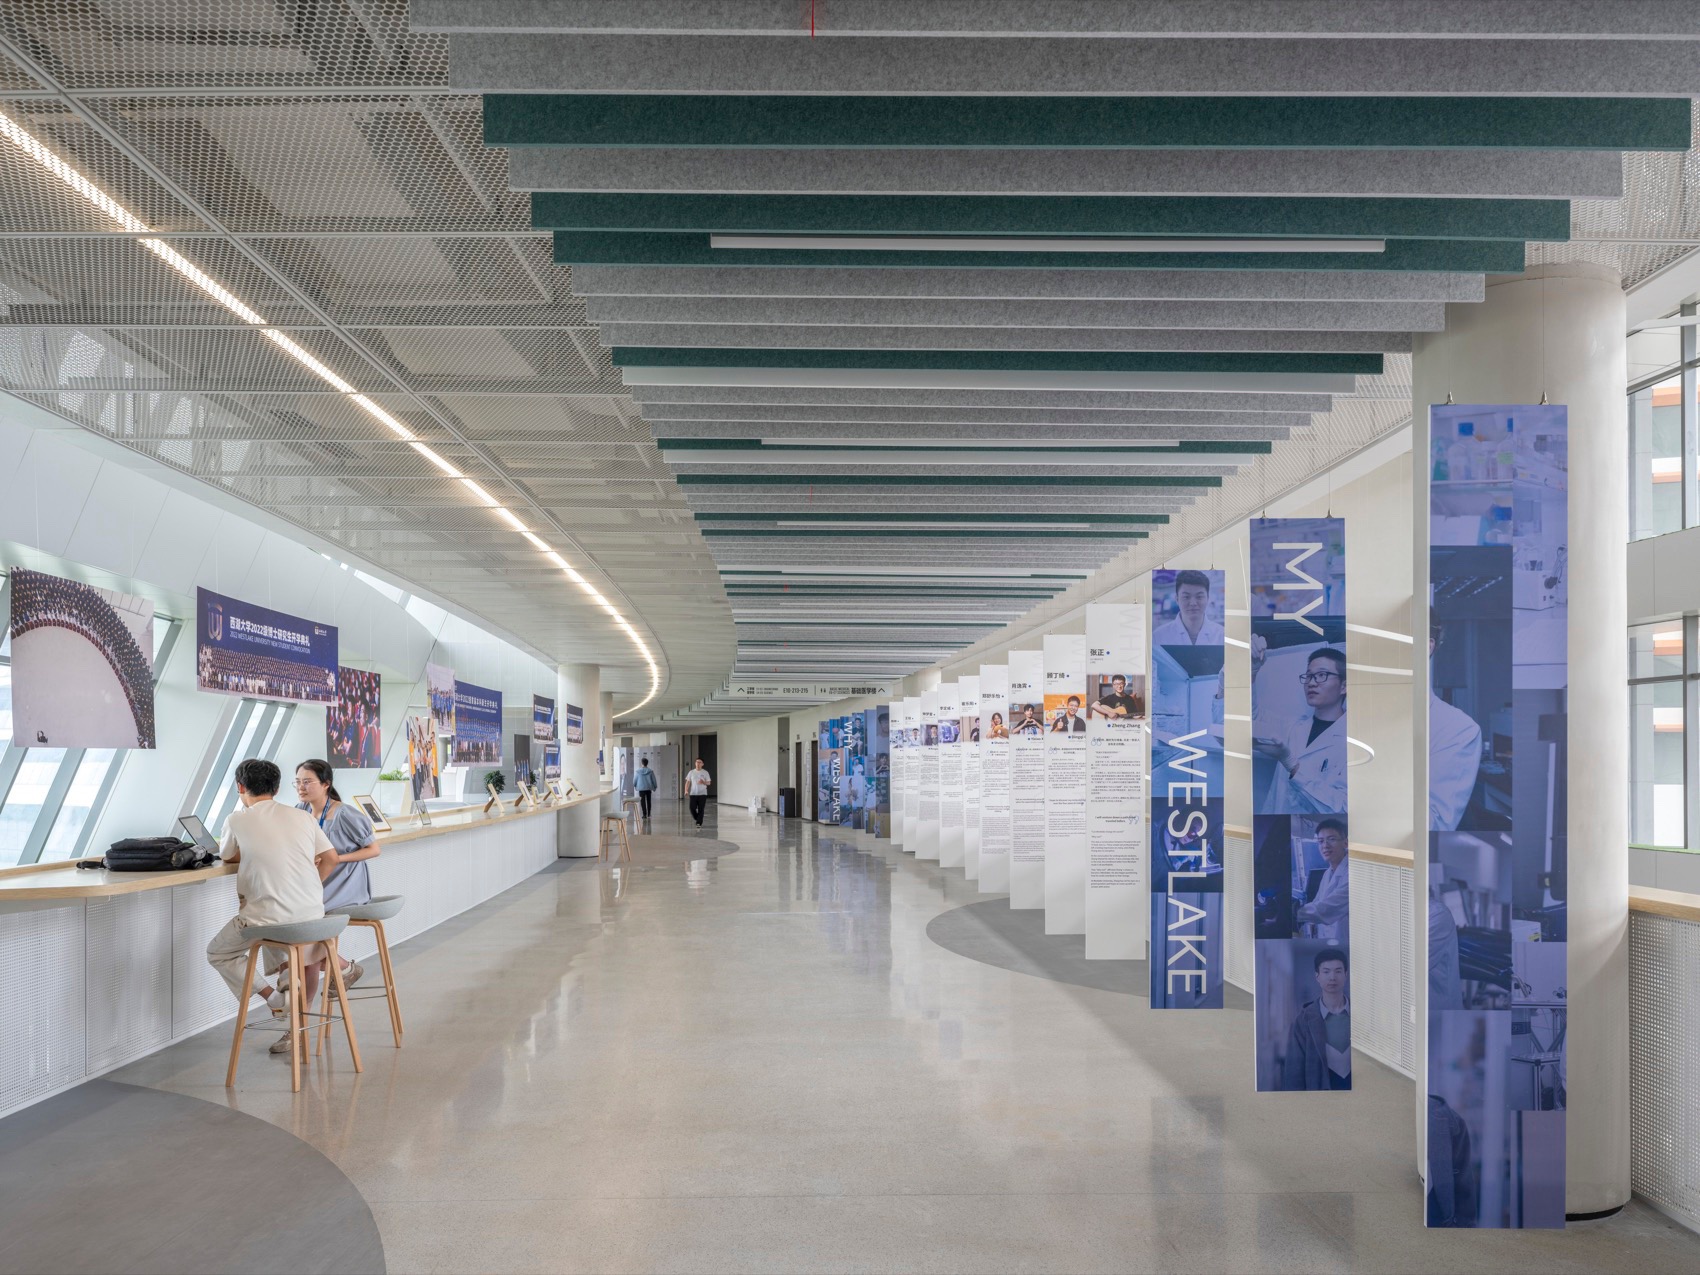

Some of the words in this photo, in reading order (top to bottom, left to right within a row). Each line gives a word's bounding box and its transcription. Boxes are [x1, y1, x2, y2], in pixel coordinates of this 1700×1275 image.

[1272, 542, 1324, 636] MY
[238, 632, 254, 642] WESTLAKE
[1120, 608, 1142, 668] WHY
[844, 721, 852, 750] WHY
[832, 758, 841, 821] WESTLAKE
[1167, 728, 1208, 995] WESTLAKE
